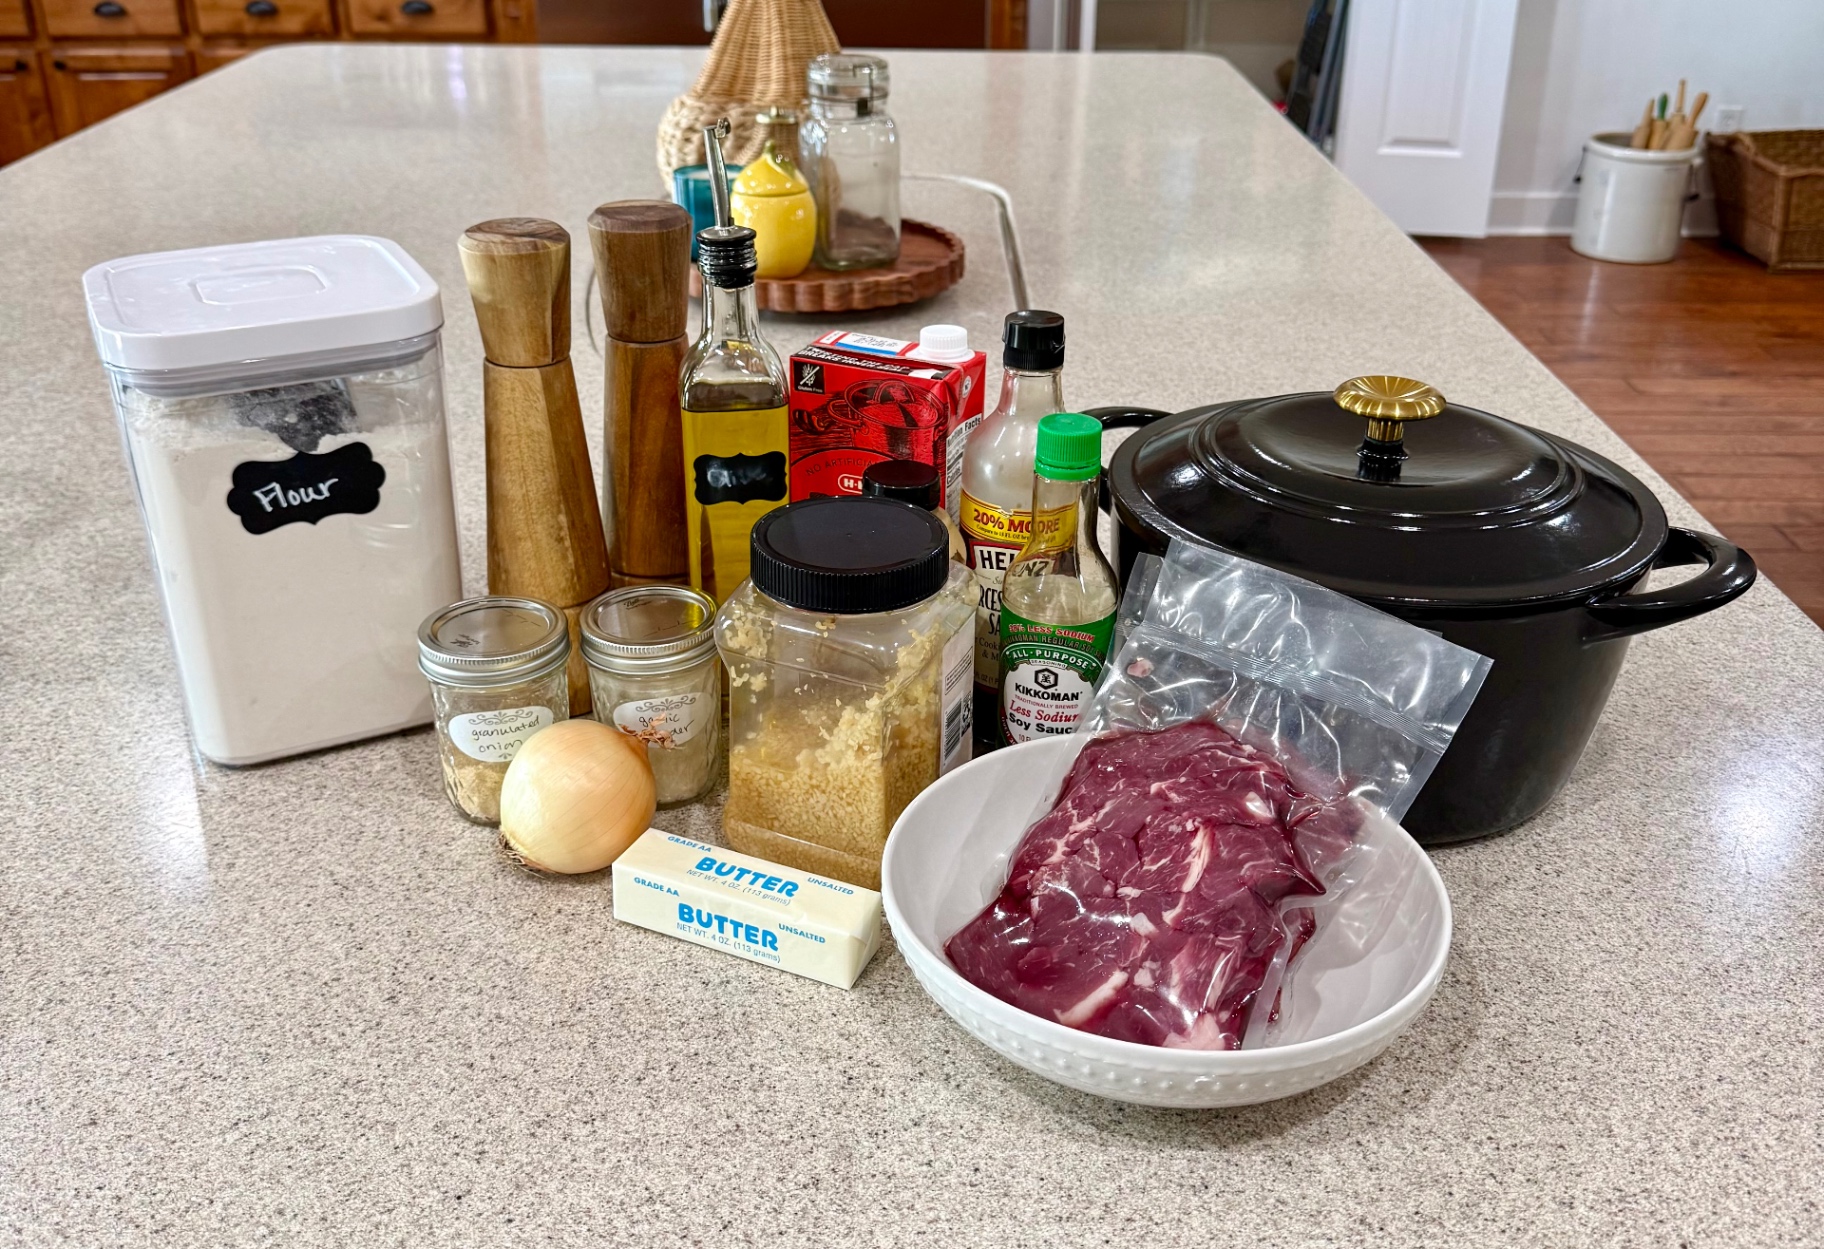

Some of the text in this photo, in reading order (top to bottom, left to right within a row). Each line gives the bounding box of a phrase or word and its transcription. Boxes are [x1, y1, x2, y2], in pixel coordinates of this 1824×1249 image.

[964, 417, 981, 432] Facts
[806, 457, 875, 476] NO ARTIFICIA
[253, 478, 339, 512] Flour
[973, 508, 1005, 530] 20%
[1027, 624, 1053, 635] LESS
[1055, 628, 1095, 643] SODIUM
[1041, 635, 1079, 649] REGULAR
[1014, 694, 1054, 709] TRADITIONALLY
[1015, 682, 1080, 701] KIKKOMAN
[1010, 700, 1031, 718] Less
[472, 715, 540, 741] granulated
[1009, 712, 1074, 735] Soy Sauc
[478, 739, 523, 753] onion
[667, 835, 712, 853] GRADE AA
[634, 876, 680, 898] GRADE AA
[686, 868, 704, 879] NET
[703, 873, 719, 884] WT.
[742, 885, 762, 898] (113
[761, 892, 791, 907] grams)
[695, 856, 800, 898] BUTTER
[807, 876, 855, 896] UNSALTED
[678, 902, 779, 952] BUTTER
[778, 923, 826, 945] UNSALTED
[676, 922, 693, 935] NET
[693, 926, 710, 940] WT.
[711, 932, 717, 941] 4
[733, 939, 751, 953] (113
[753, 948, 781, 964] grams)
